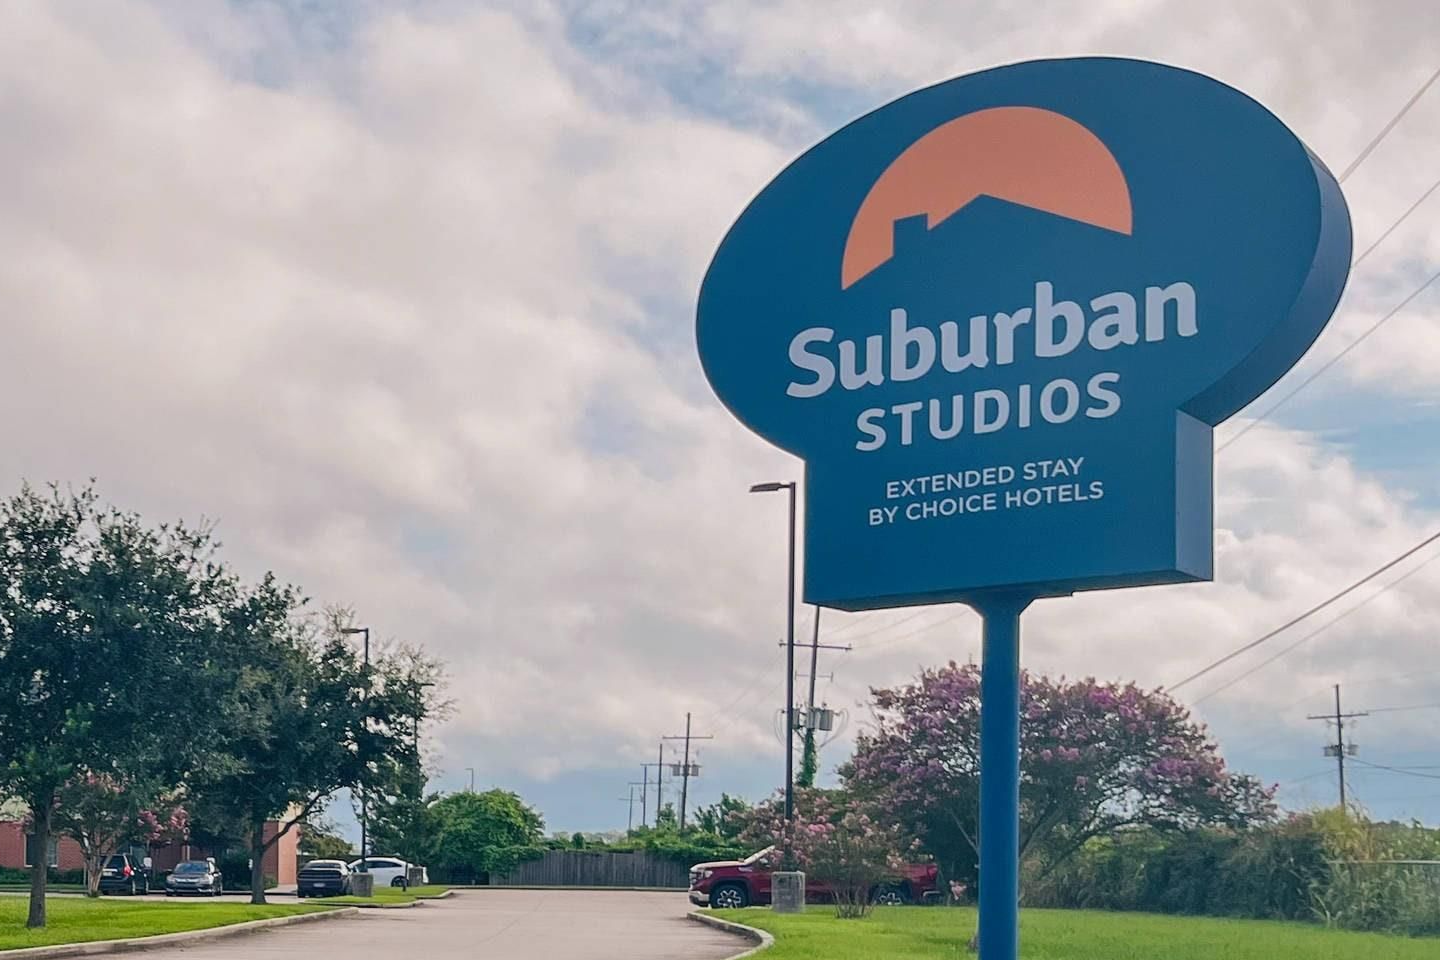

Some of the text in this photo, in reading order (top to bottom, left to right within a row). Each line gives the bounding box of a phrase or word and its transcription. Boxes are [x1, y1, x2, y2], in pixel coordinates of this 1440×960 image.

[786, 281, 1198, 398] Suburban
[855, 372, 1122, 452] STUDIOS
[868, 481, 1104, 526] BY CHOICE HOTELS
[886, 456, 1085, 499] EXTENDED STAY
